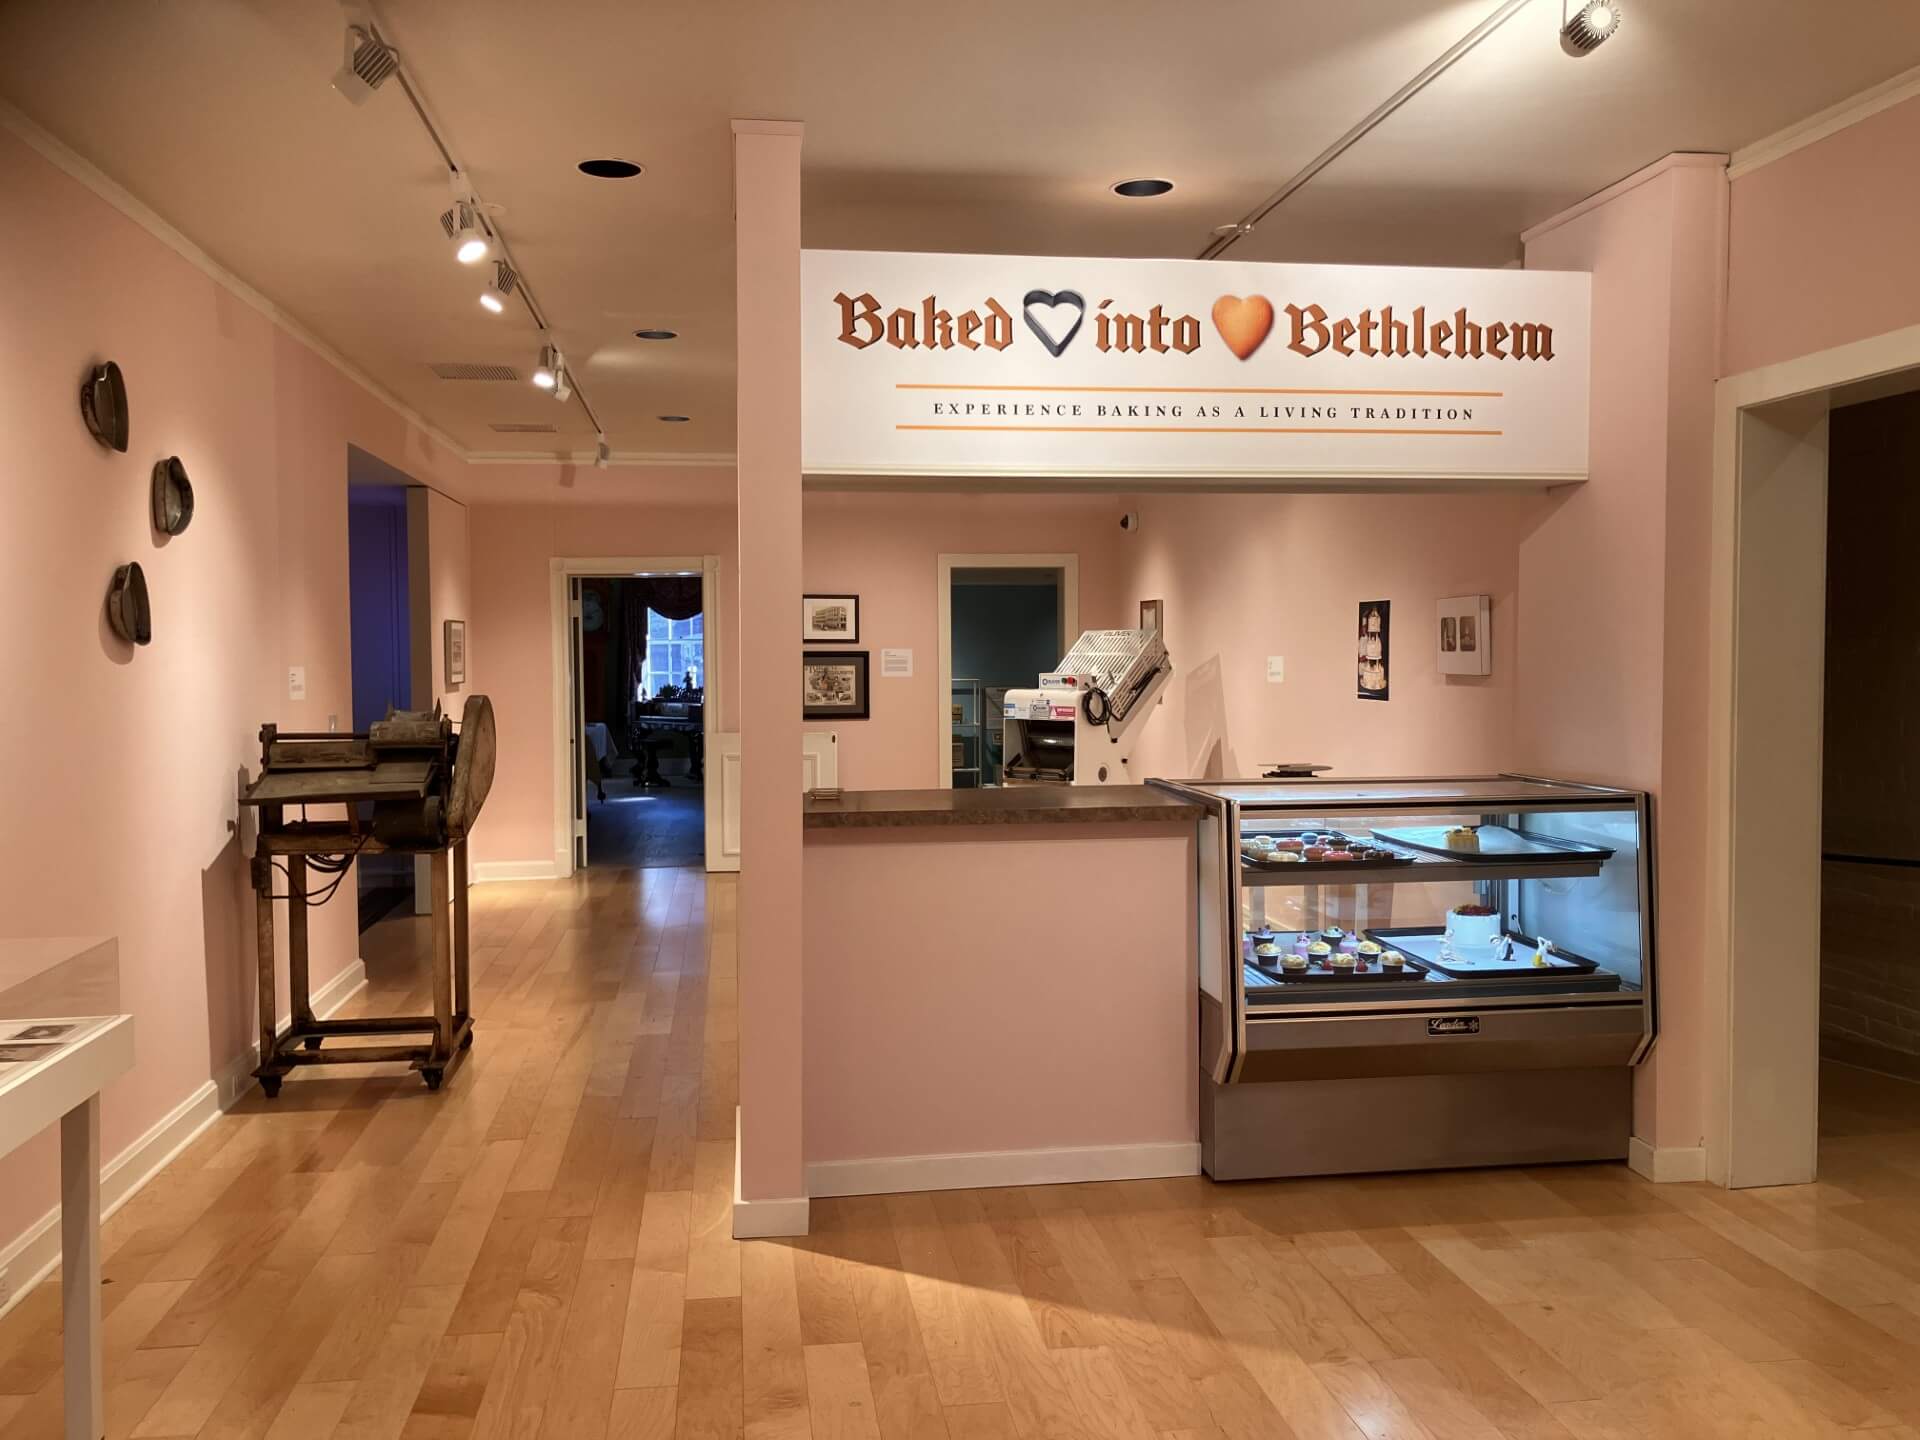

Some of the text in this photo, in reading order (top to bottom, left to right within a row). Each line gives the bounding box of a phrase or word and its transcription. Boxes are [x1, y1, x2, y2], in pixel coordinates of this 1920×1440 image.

[833, 292, 1555, 361] Baked into Bethlehem
[934, 403, 1474, 420] EXPERIENCE BAKING AS A LIVING TRADITION
